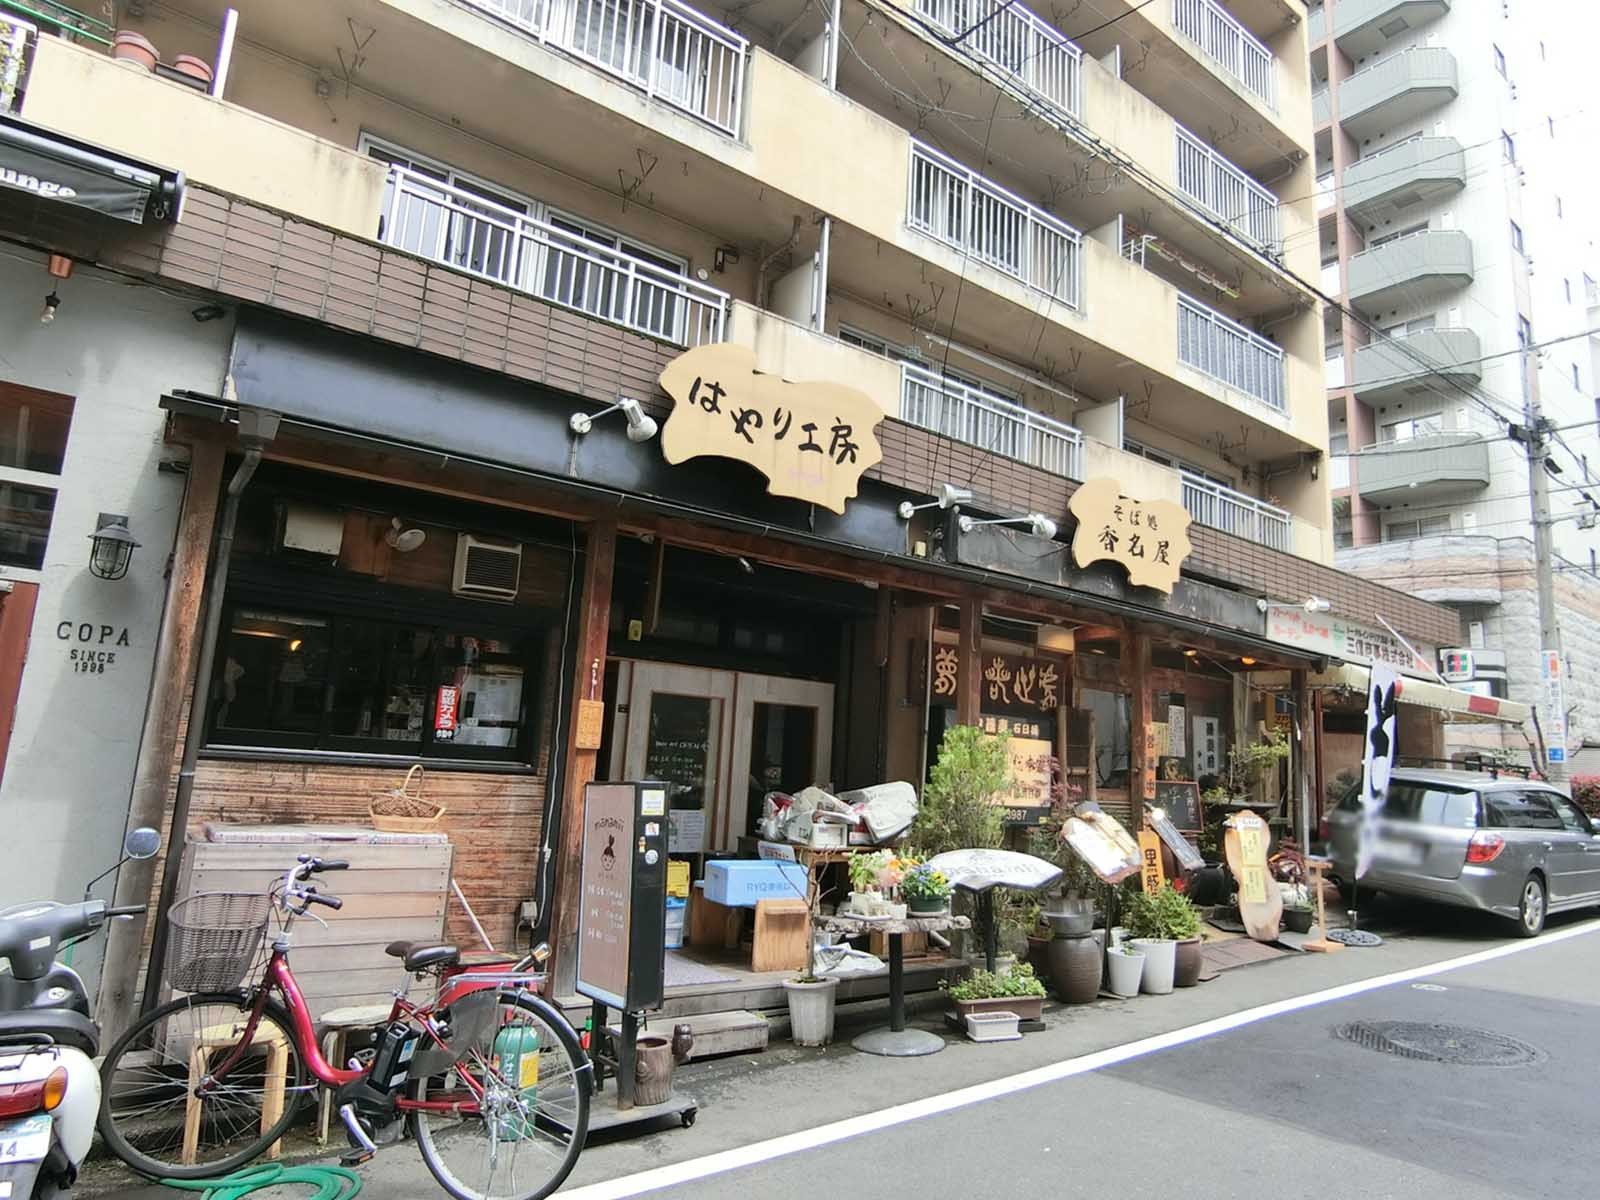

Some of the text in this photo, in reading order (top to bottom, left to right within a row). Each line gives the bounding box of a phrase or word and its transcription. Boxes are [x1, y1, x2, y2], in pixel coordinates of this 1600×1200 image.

[688, 376, 860, 465] はやり工房
[1112, 504, 1159, 531] そば処
[57, 621, 130, 647] COPA
[70, 649, 116, 664] SINCE
